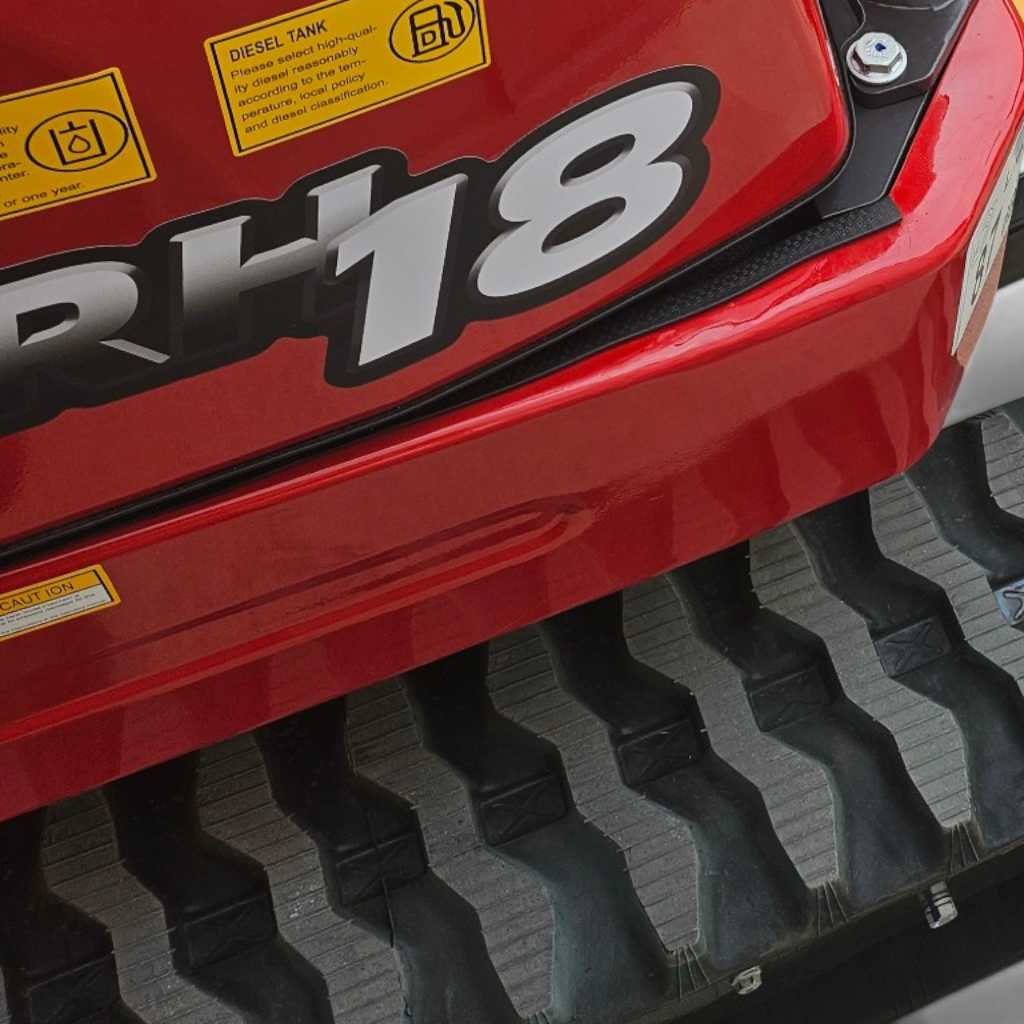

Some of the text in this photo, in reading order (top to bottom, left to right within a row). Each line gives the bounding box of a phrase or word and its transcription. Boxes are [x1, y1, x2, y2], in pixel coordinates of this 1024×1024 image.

[229, 20, 327, 62] DIESEL TANK
[231, 25, 377, 79] Please select high-qual-
[234, 46, 358, 94] ity diesel reasonably
[238, 60, 366, 107] according to the tem-
[241, 73, 365, 122] perature, local policy
[245, 79, 388, 133] and diesel classification.
[4, 182, 84, 208] or one year.
